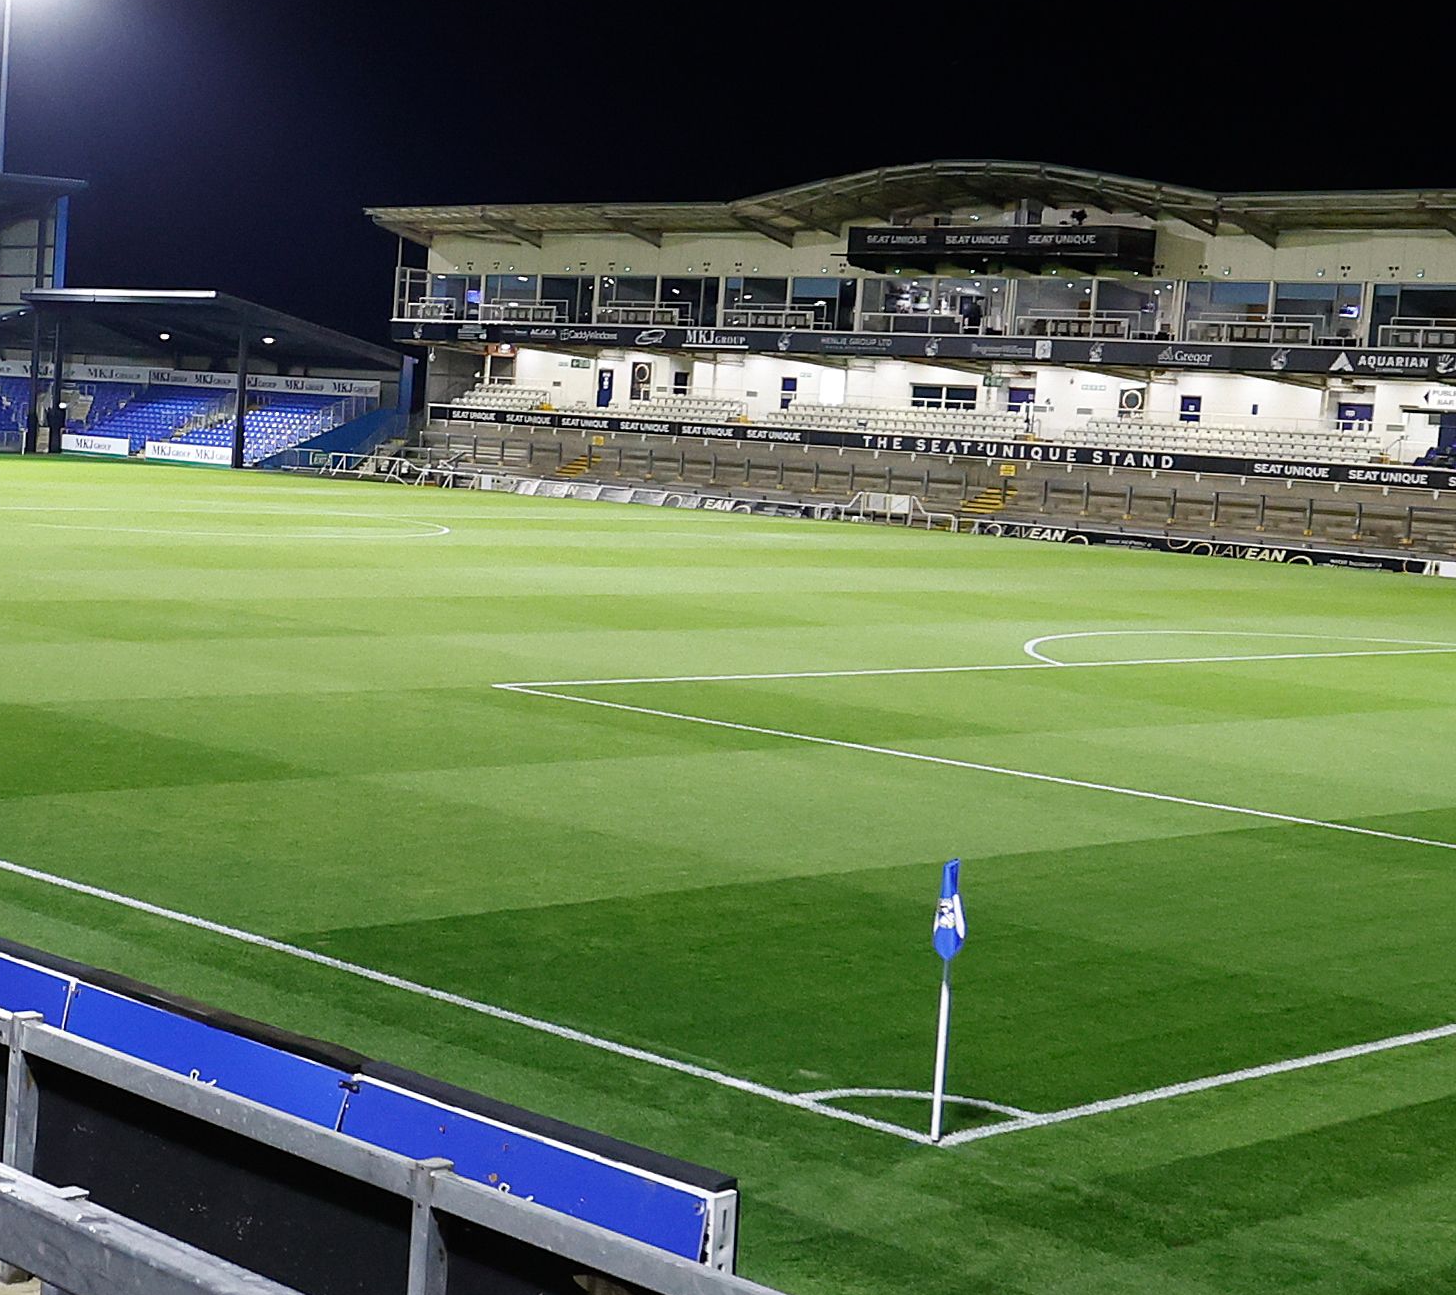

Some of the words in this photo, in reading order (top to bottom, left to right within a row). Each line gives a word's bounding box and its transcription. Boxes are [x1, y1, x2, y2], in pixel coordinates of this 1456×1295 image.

[945, 235, 970, 244] SEAT
[971, 235, 1010, 245] UNIQUE
[1027, 234, 1054, 244] SEAT
[1055, 234, 1096, 245] UNIQUE
[685, 330, 715, 344] MKJ
[715, 336, 746, 345] GROUP
[1175, 351, 1212, 366] Gregor
[1357, 354, 1429, 370] AQUARIAN
[88, 367, 114, 378] MKJ
[152, 372, 170, 382] MKJ
[452, 410, 469, 419] SEAT
[470, 412, 496, 422] UNIQUE
[505, 413, 523, 423] SEAT
[524, 415, 551, 426] UNIQUE
[561, 417, 580, 426] SEAT
[580, 419, 609, 429] UNIQUE
[620, 421, 639, 431] SEAT
[640, 423, 670, 433] UNIQUE
[682, 424, 701, 434] SEAT
[703, 426, 734, 437] UNIQUE
[746, 428, 767, 438] SEAT
[769, 430, 802, 442] UNIQUE
[75, 438, 94, 449] MKJ
[151, 444, 171, 456] MKJ
[195, 447, 214, 459] MKJ
[863, 435, 903, 451] THE
[916, 438, 971, 454] SEAT
[985, 442, 1077, 462] UNIQUE
[1092, 450, 1174, 469] STAND
[1253, 463, 1284, 475] SEAT
[1285, 465, 1329, 478] UNIQUE
[1348, 469, 1379, 482] SEAT
[1380, 472, 1428, 486] UNIQUE
